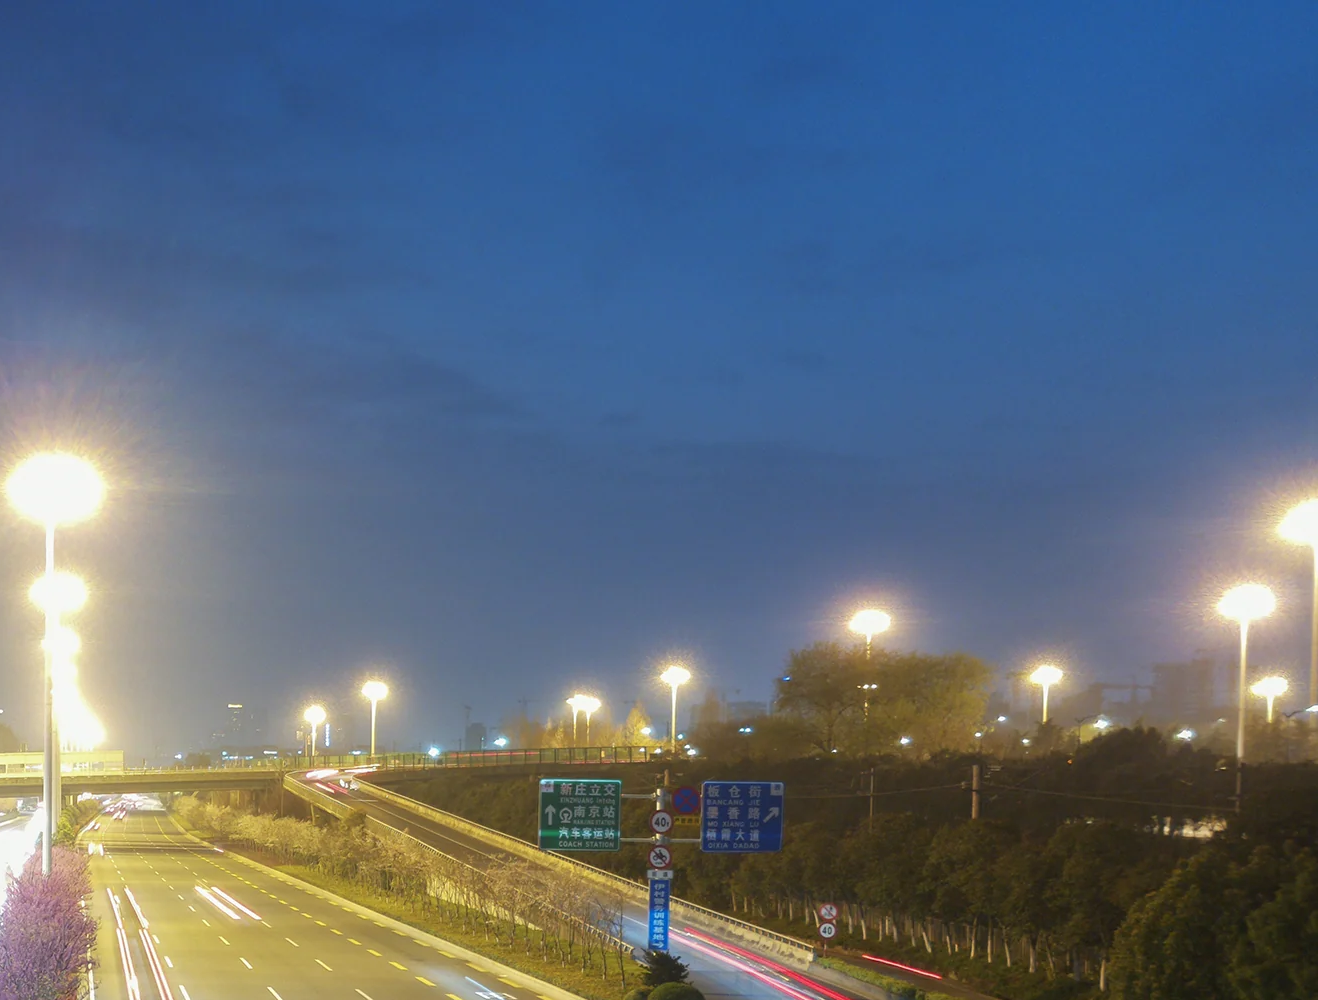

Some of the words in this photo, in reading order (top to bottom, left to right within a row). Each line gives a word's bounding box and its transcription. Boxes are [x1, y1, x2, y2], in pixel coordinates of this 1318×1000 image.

[560, 783, 615, 796] 新庄立交
[707, 785, 762, 798] 板仓街
[573, 806, 615, 818] 南京站
[559, 827, 615, 839] 汽车客运站
[822, 926, 832, 935] 40
